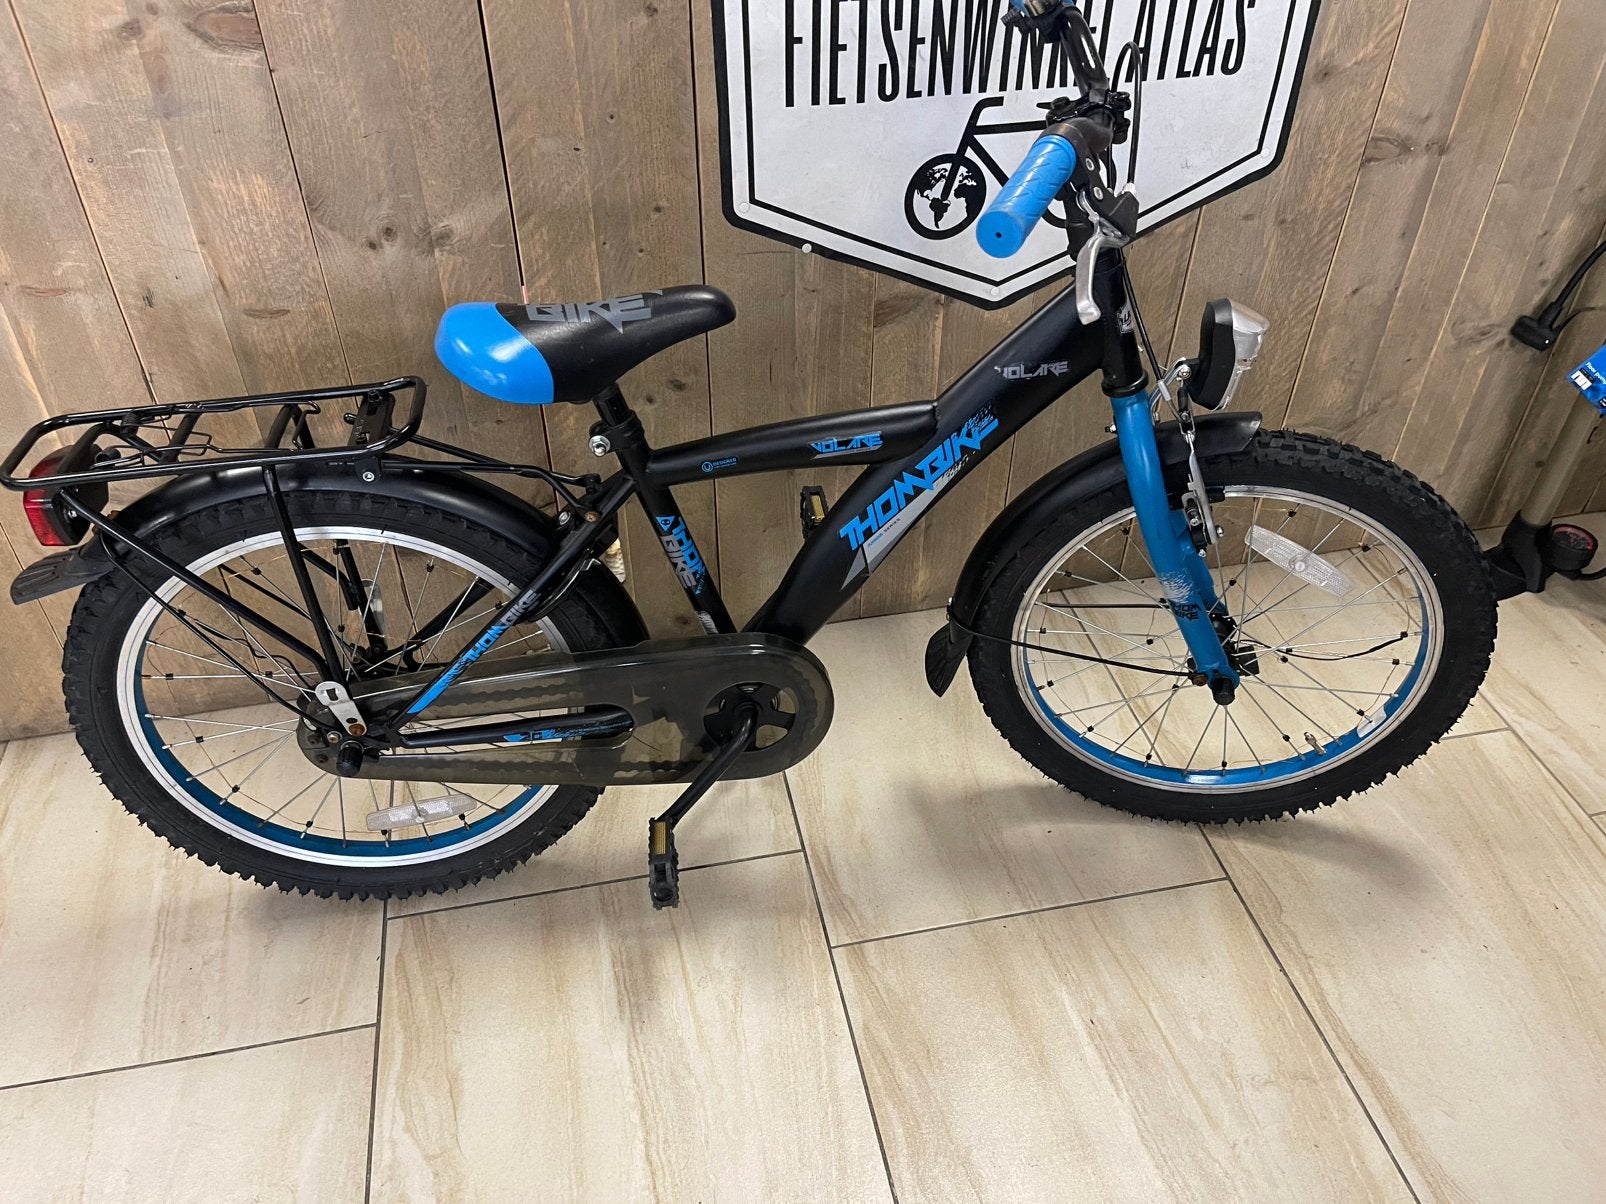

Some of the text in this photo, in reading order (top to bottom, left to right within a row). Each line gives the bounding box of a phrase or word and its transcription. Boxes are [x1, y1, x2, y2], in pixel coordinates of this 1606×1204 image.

[1124, 0, 1255, 84] ATLAS
[526, 294, 652, 334] BIKE
[810, 431, 883, 454] VOLARE
